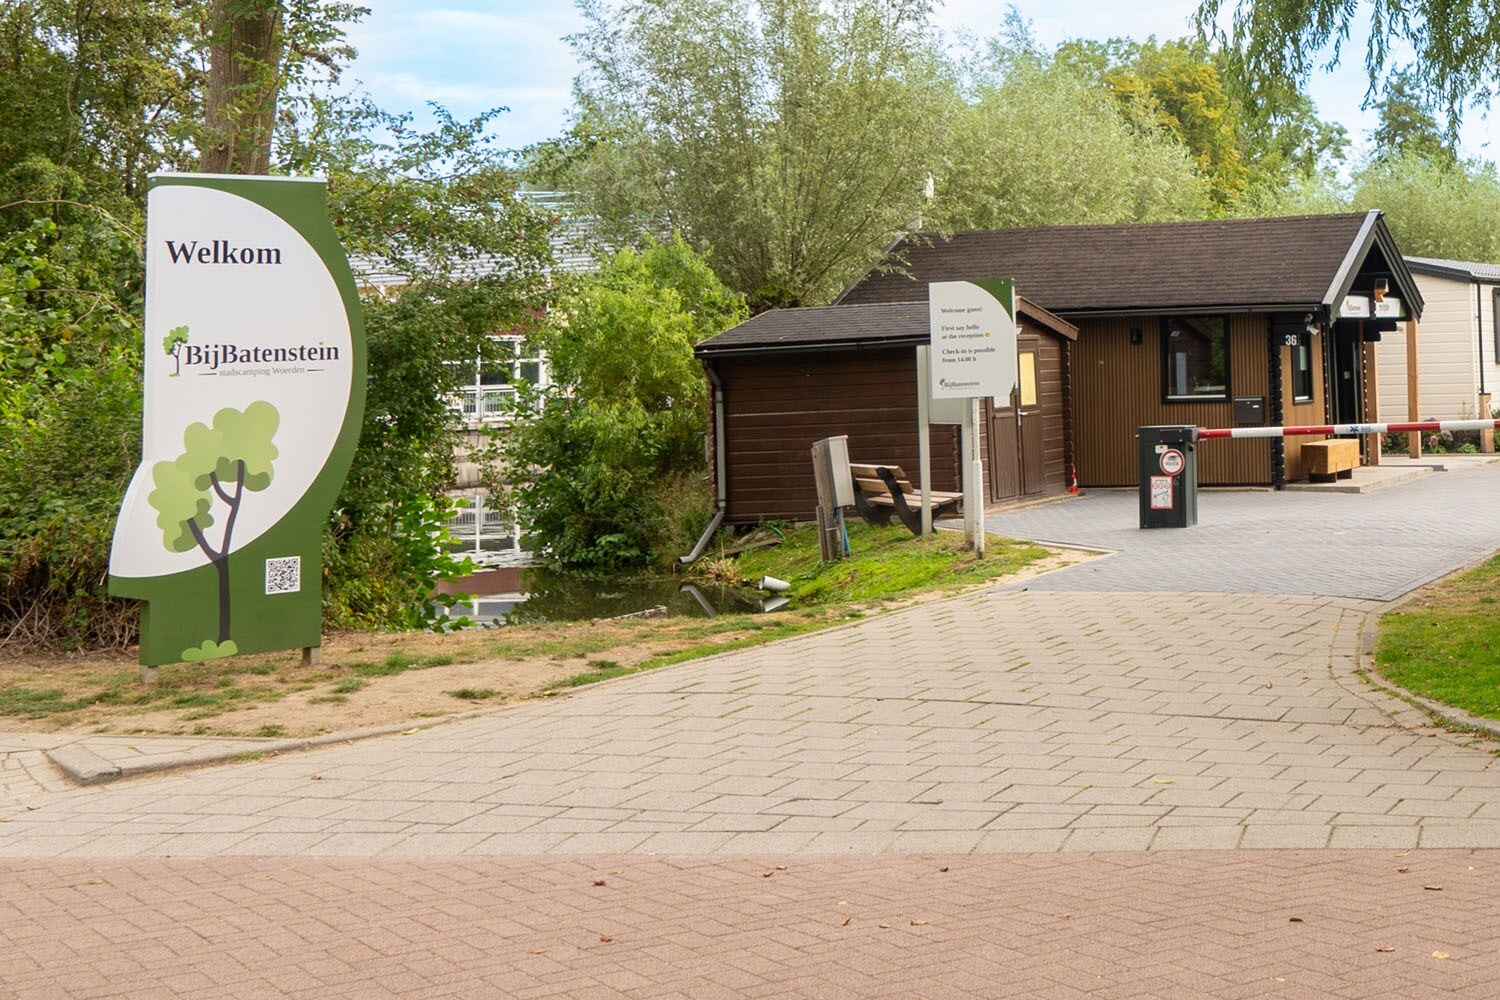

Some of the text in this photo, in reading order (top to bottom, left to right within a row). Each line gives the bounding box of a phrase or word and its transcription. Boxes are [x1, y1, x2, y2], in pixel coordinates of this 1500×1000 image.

[165, 239, 282, 266] Welkom
[1285, 334, 1297, 346] 36
[184, 340, 340, 370] BijBatenstein
[219, 365, 305, 377] stadscamping Woerden
